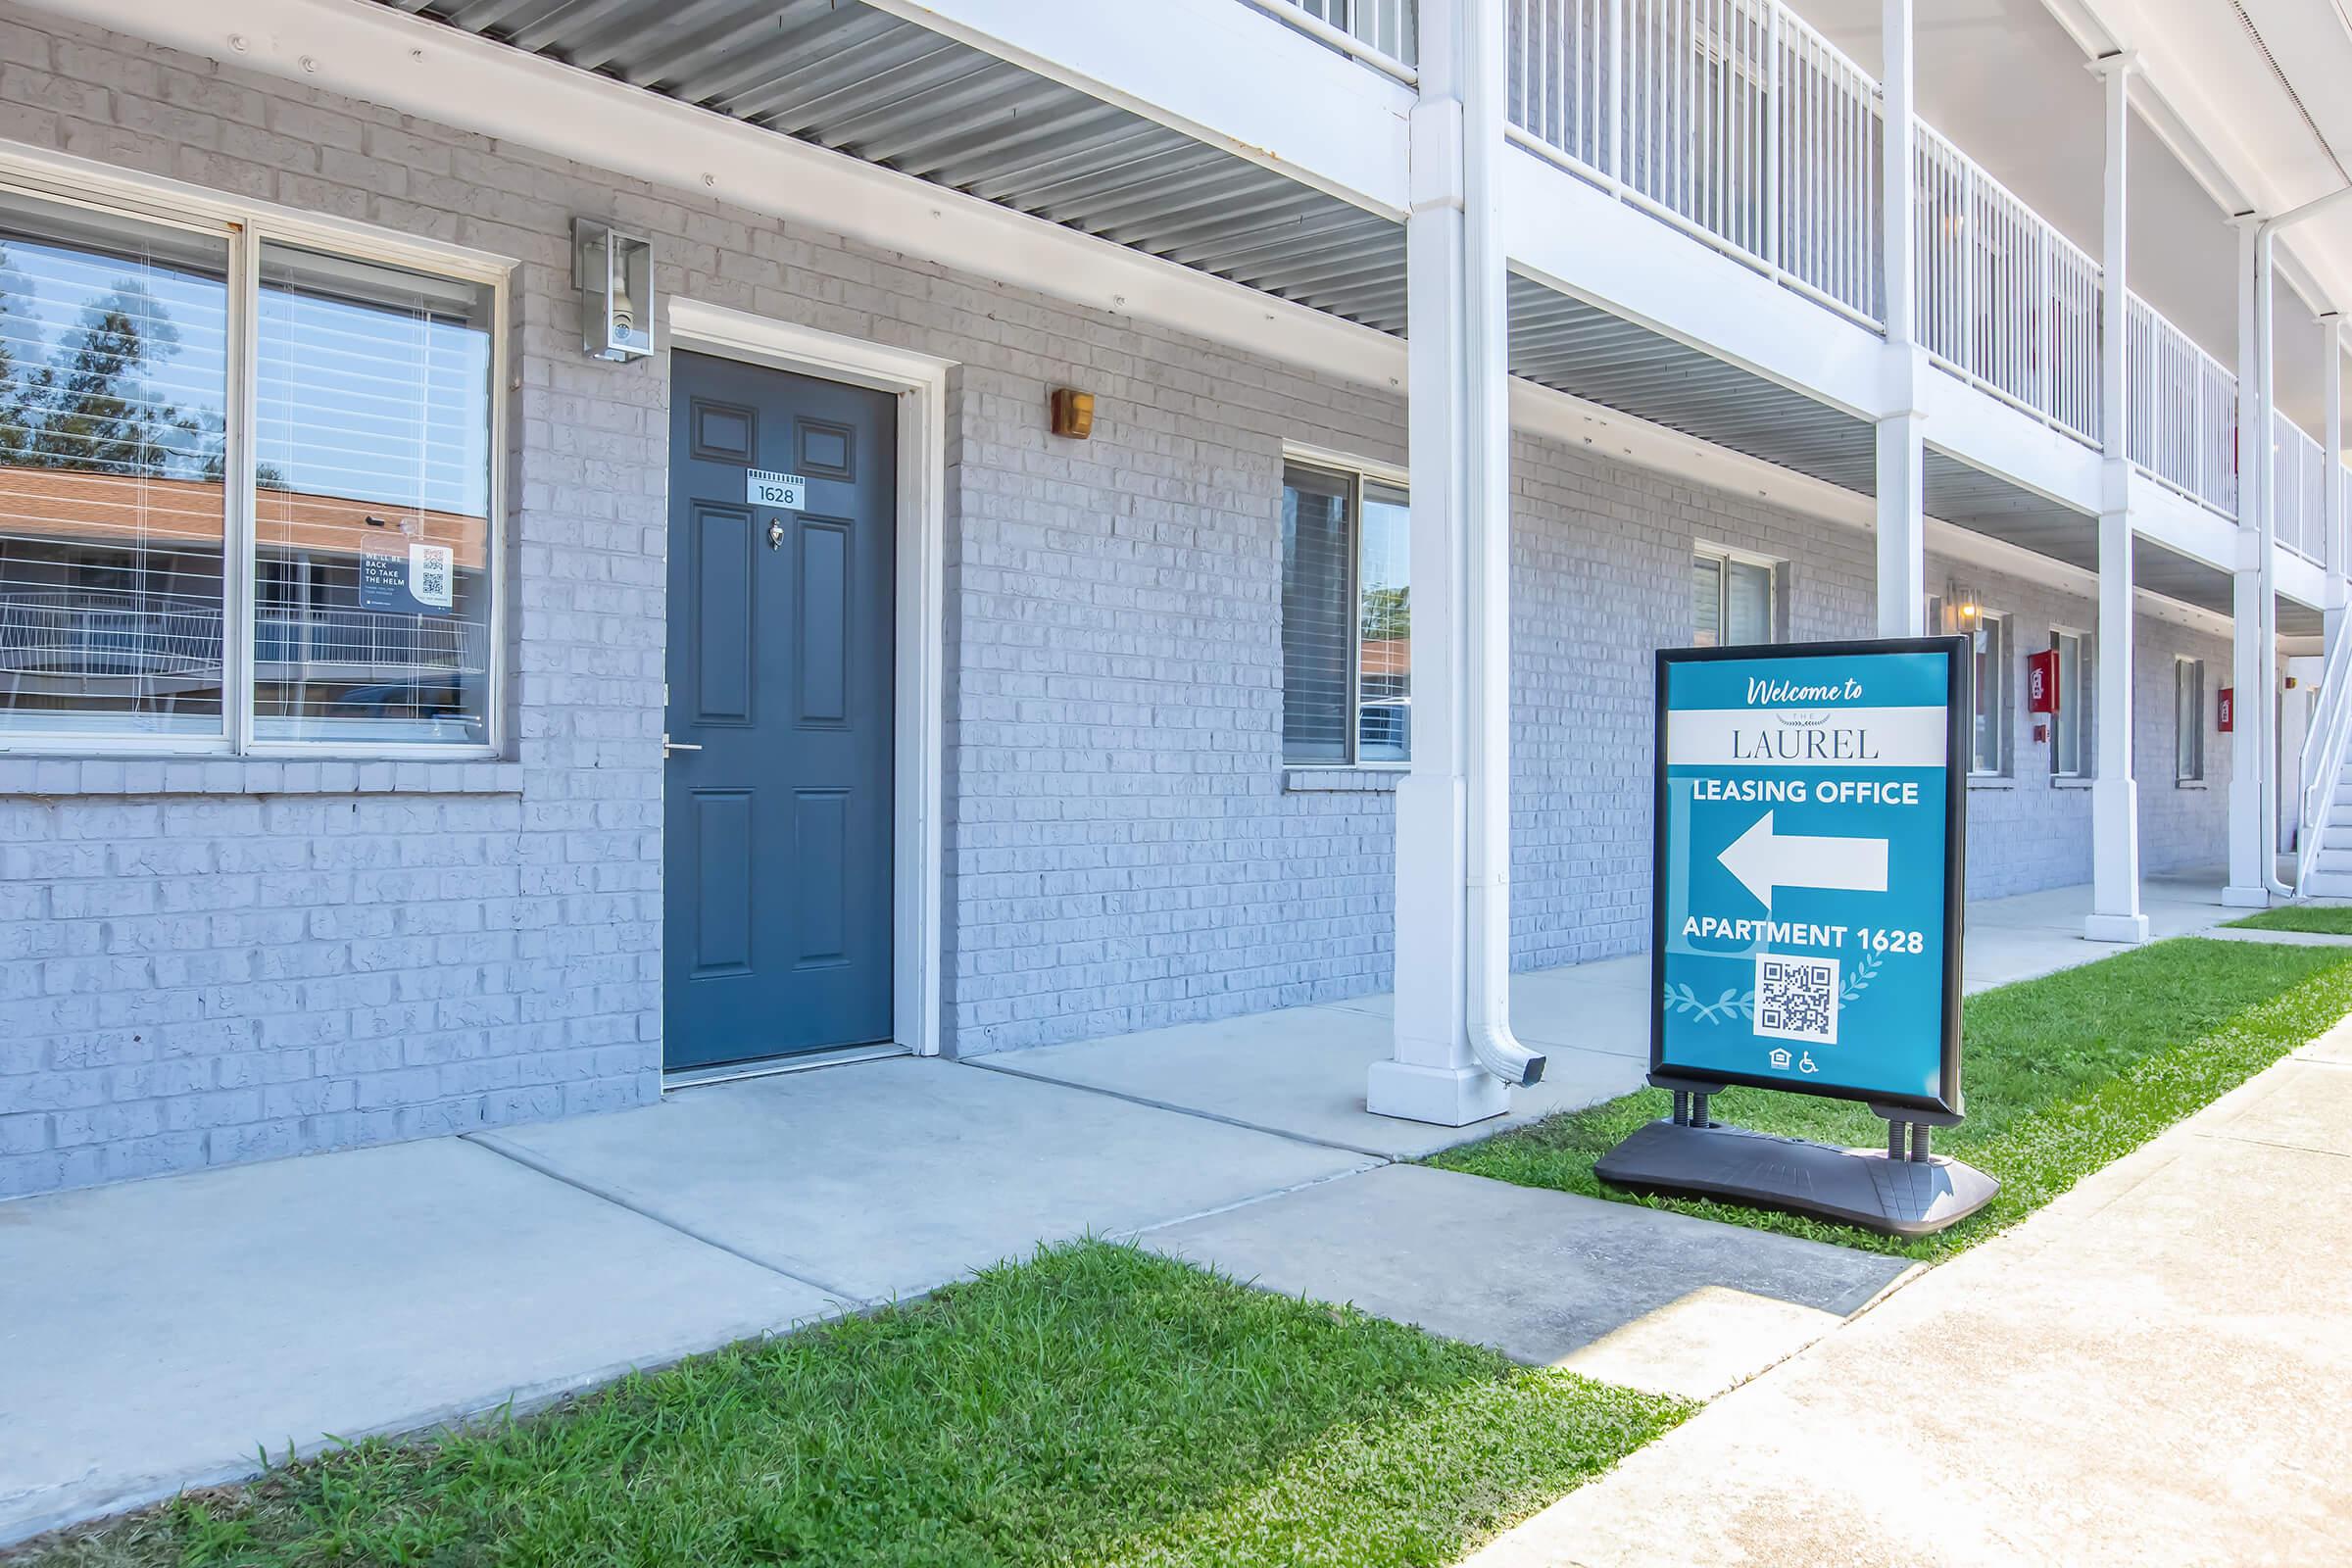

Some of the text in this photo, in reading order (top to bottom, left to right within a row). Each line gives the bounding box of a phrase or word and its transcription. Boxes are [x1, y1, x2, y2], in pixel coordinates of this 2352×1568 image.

[759, 486, 794, 504] 1628
[366, 560, 387, 568] BACK
[379, 569, 399, 578] TAKE
[1746, 676, 1863, 705] Welcome to
[1732, 728, 1880, 760] LAUREL
[1692, 779, 1919, 805] LEASING OFFICE
[1682, 916, 1924, 955] APARTMENT 1628
